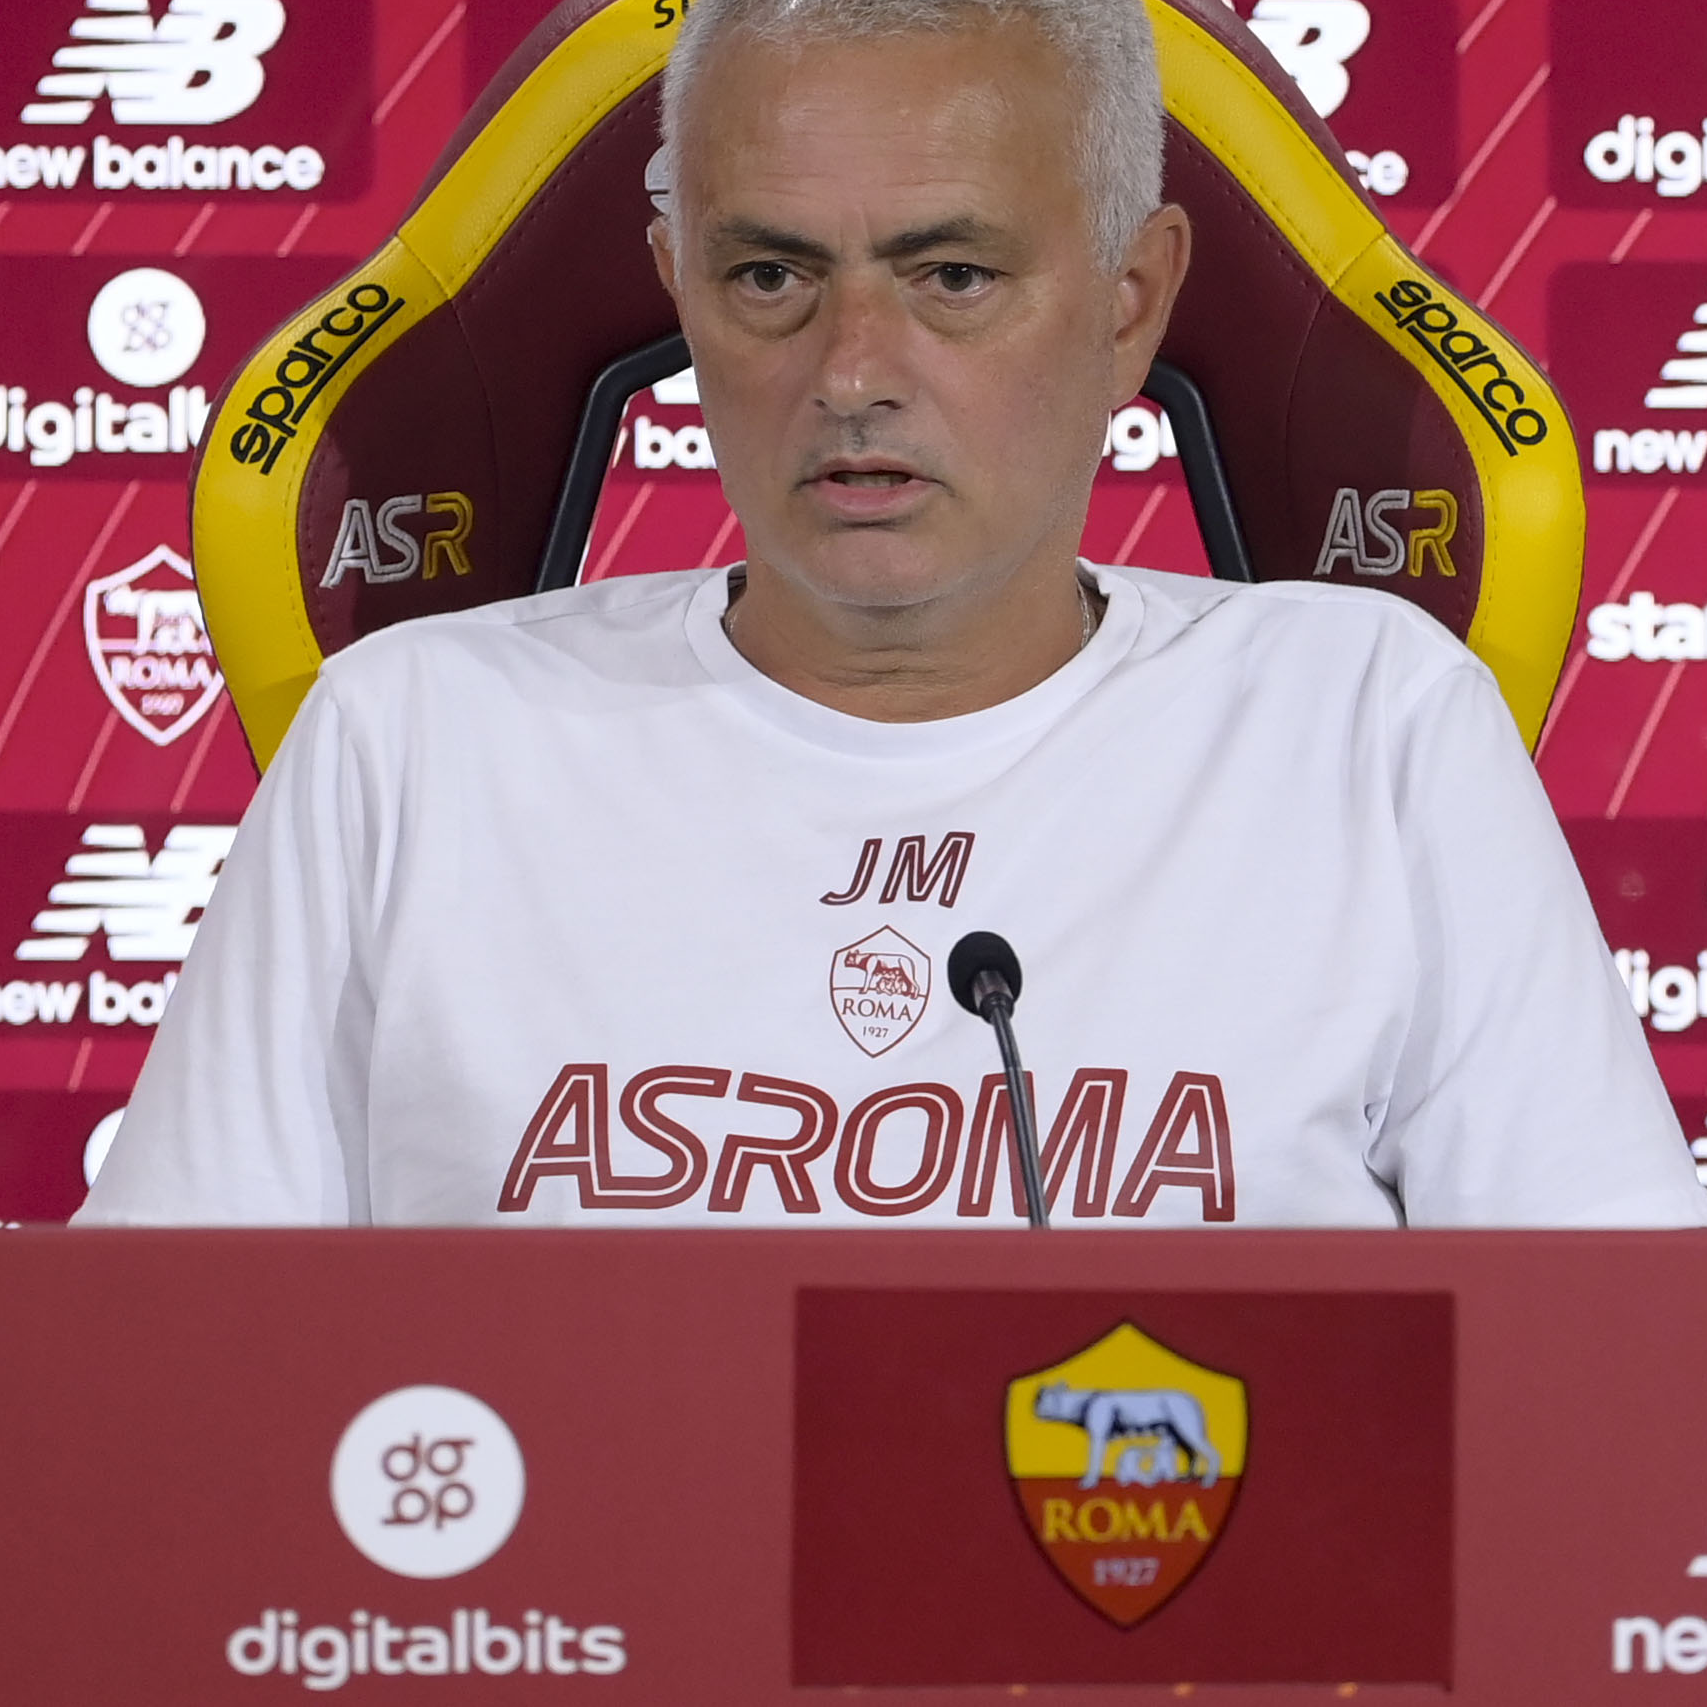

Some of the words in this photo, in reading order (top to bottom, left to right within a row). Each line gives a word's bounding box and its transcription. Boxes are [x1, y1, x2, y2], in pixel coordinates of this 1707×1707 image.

[94, 136, 324, 190] balance
[230, 284, 391, 466] sparco
[1388, 280, 1548, 446] sparco
[319, 491, 473, 588] ASR
[1313, 488, 1457, 578] ASR
[819, 831, 975, 908] JM
[842, 998, 913, 1022] ROMA
[862, 1025, 889, 1038] 1927
[497, 1063, 1235, 1223] ASROMA
[1043, 1497, 1209, 1543] ROMA
[1093, 1557, 1161, 1586] 1927
[225, 1608, 628, 1692] digitalbits
